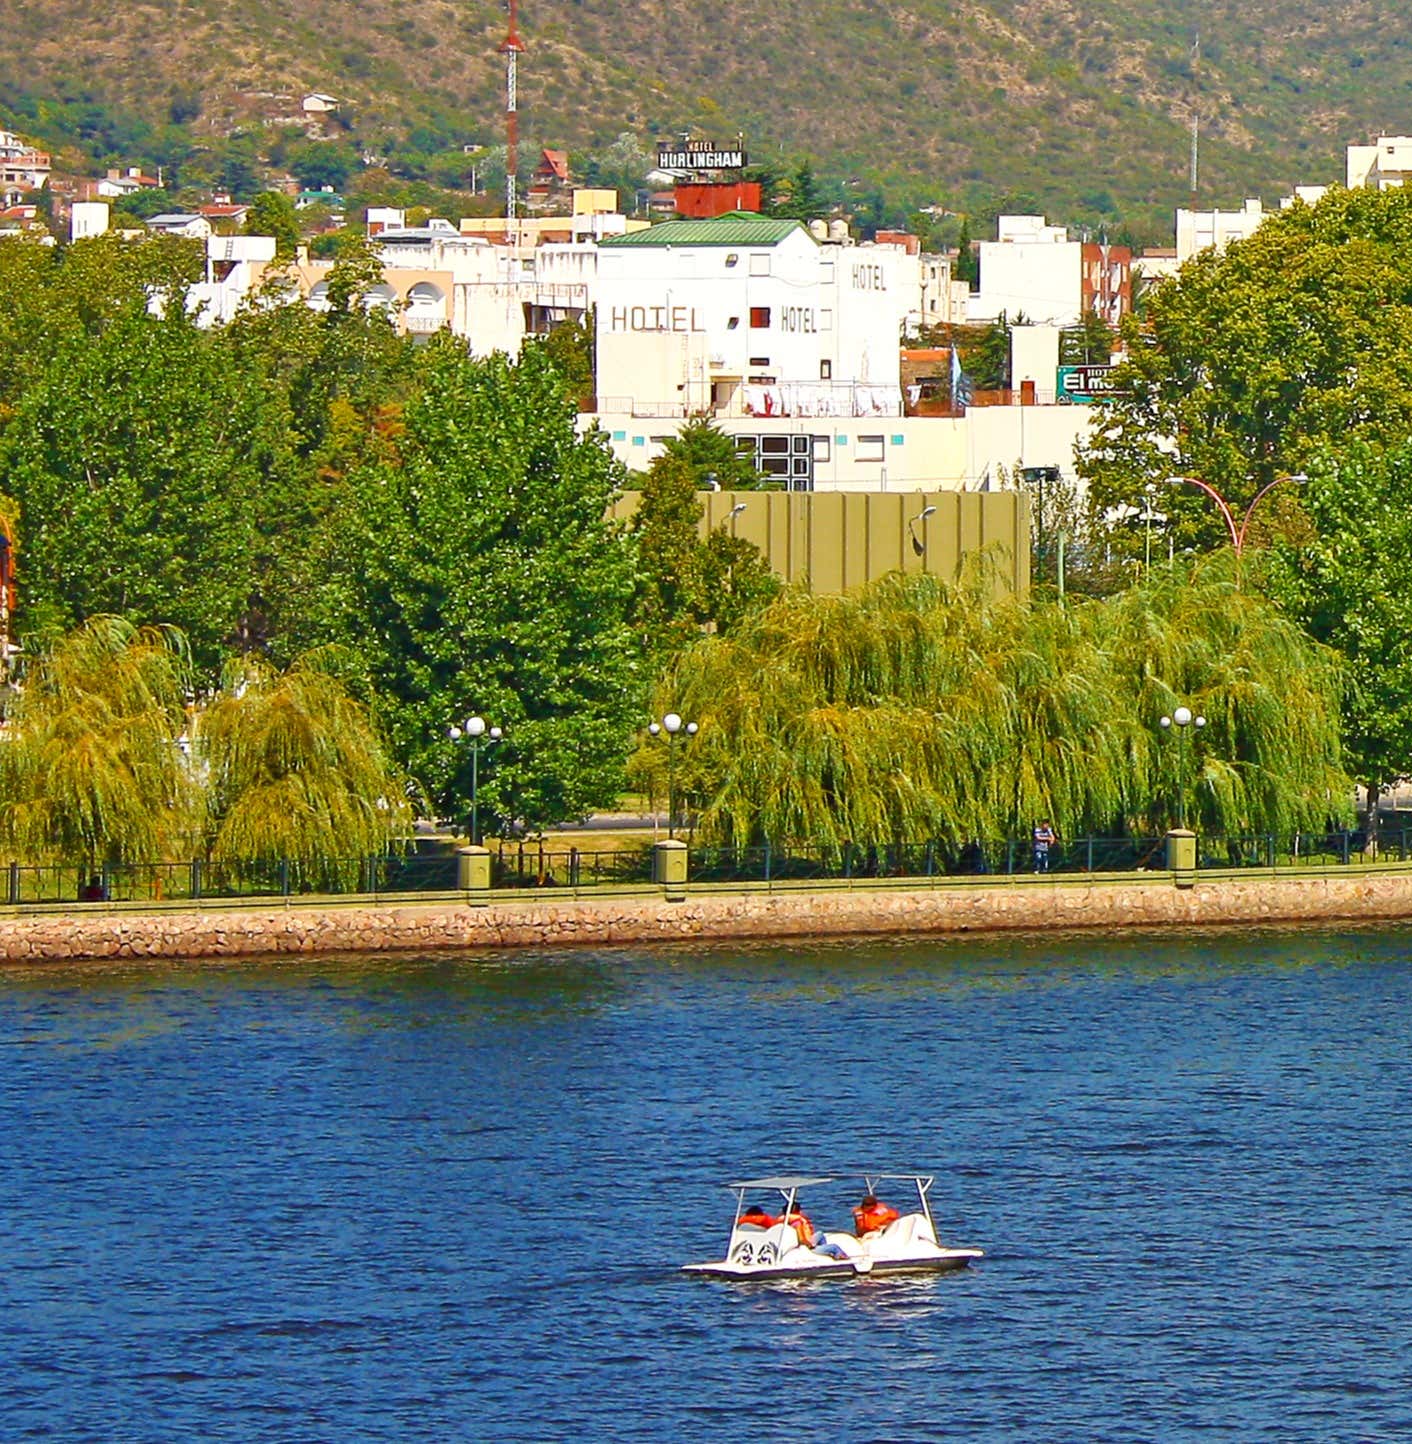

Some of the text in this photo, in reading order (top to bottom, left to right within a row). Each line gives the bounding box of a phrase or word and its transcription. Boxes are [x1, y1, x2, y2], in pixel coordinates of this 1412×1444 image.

[688, 142, 713, 151] HOTEL
[660, 152, 742, 167] HURLINGHAM
[852, 264, 887, 291] HOTEL
[612, 306, 706, 332] HOTEL
[781, 305, 817, 333] HOTEL
[1063, 373, 1085, 389] El
